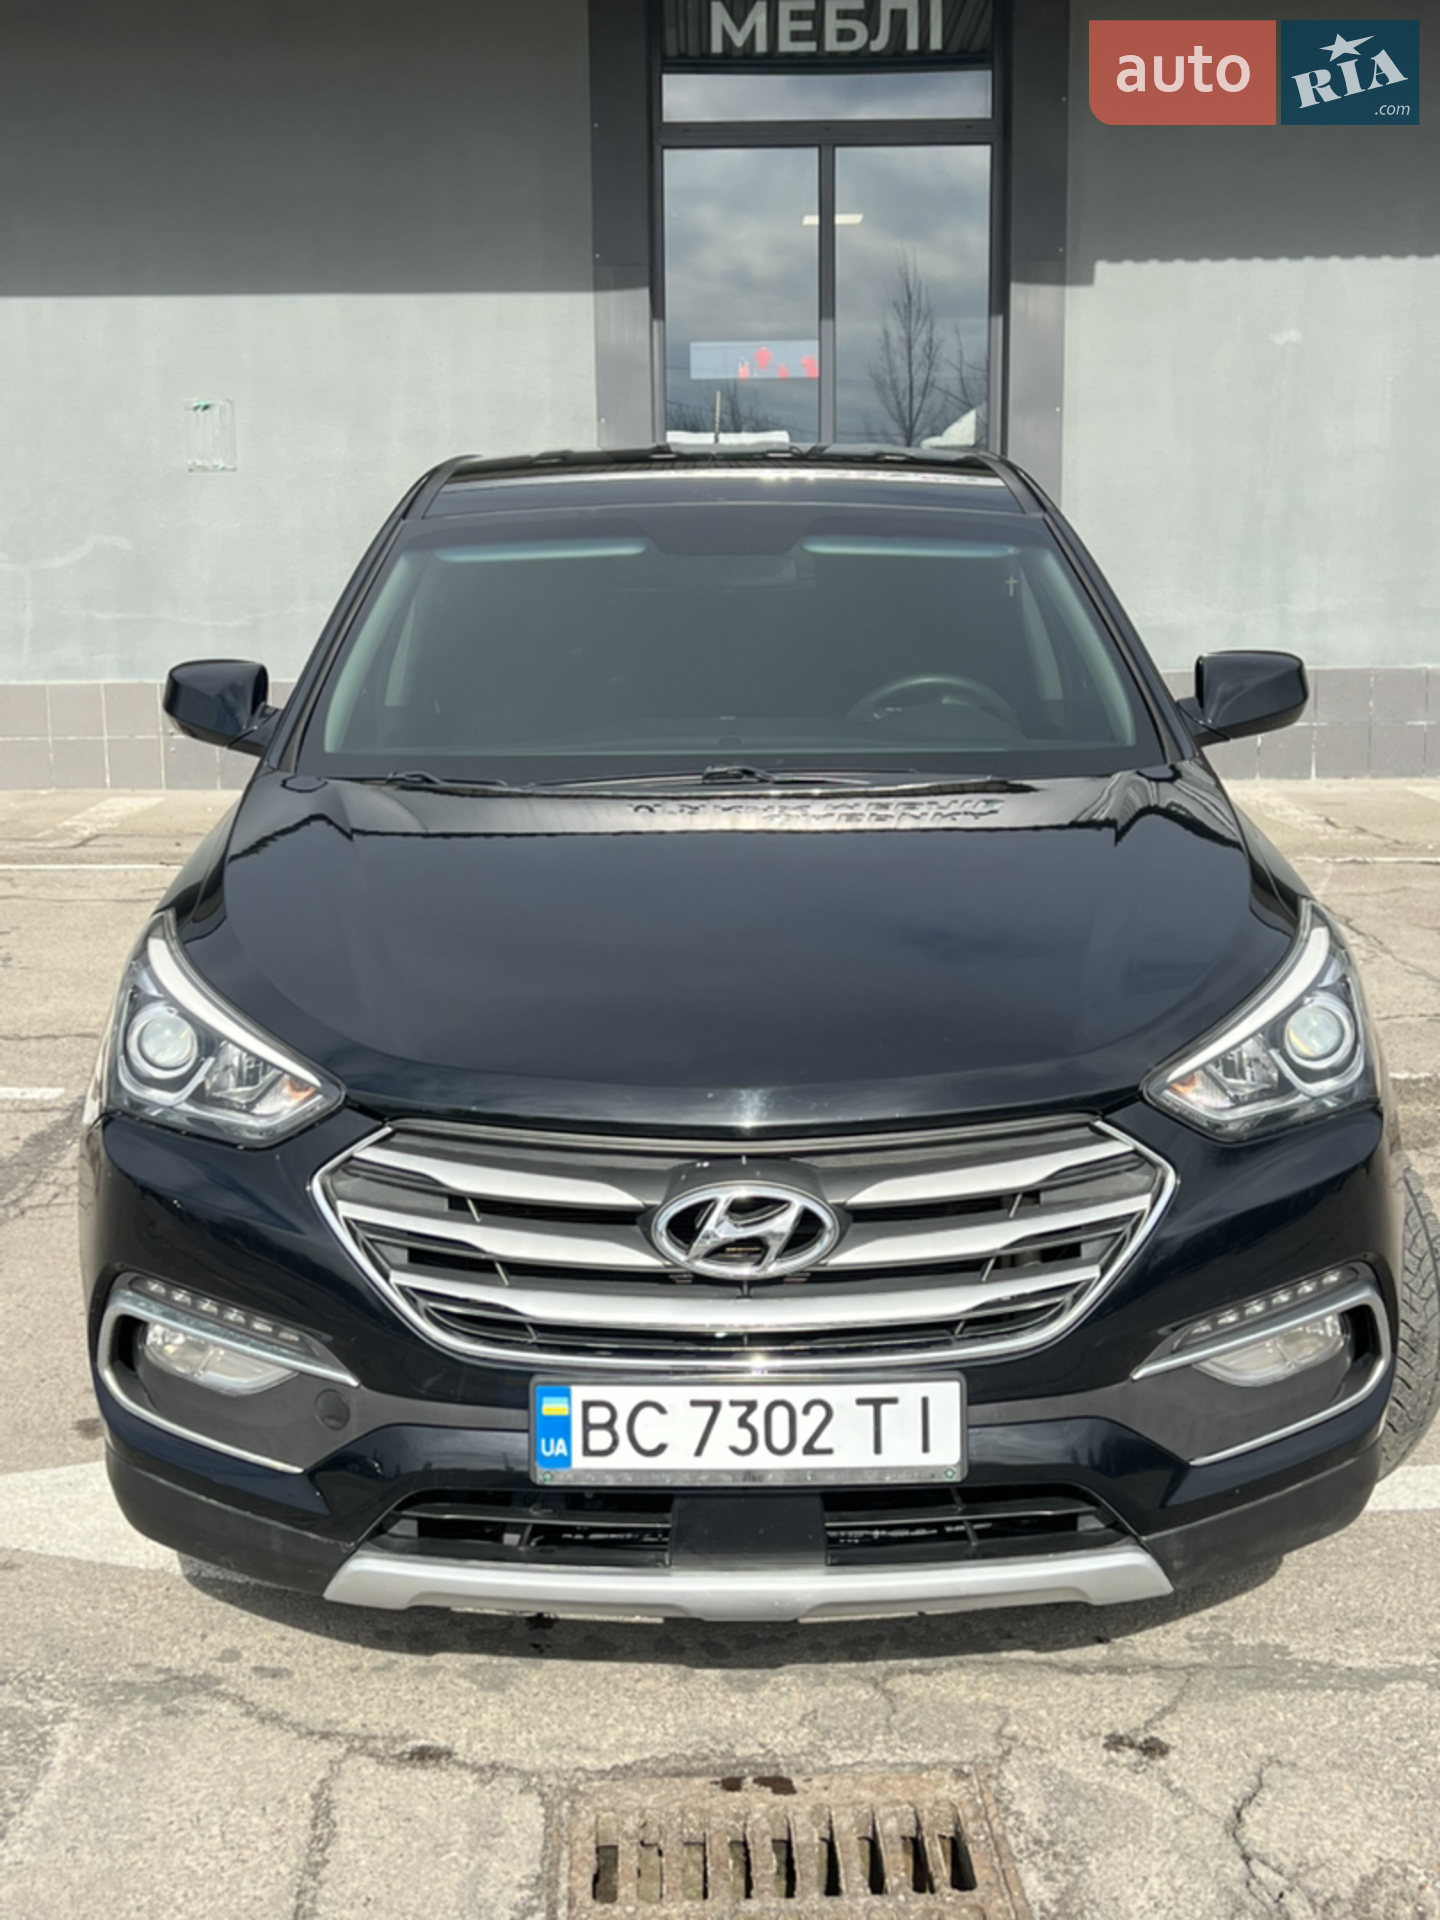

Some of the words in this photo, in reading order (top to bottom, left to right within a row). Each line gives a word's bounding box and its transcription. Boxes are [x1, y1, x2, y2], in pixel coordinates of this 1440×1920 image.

[710, 0, 943, 53] МЕБЛІ
[541, 1437, 569, 1458] UA
[581, 1399, 669, 1458] BC
[689, 1397, 835, 1457] 7302
